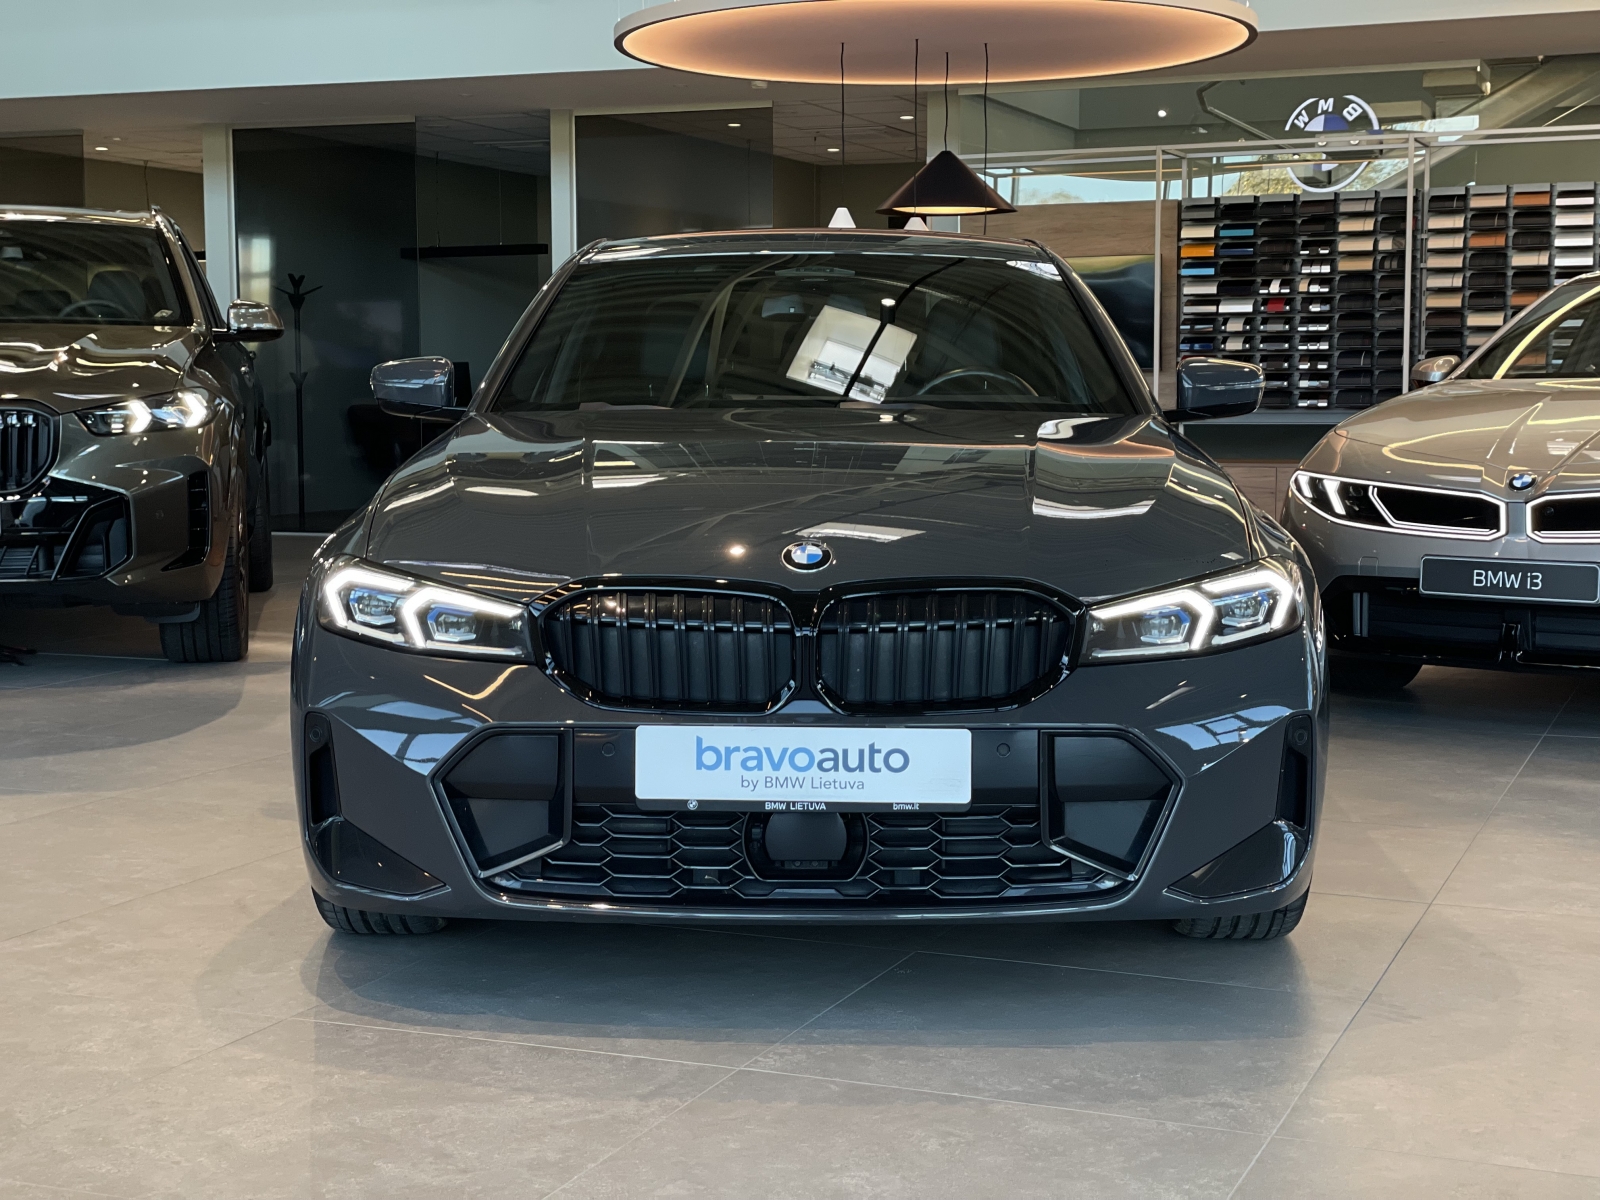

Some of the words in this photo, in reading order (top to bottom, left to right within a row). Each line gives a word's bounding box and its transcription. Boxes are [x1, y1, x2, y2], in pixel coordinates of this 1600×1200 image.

[1473, 569, 1522, 589] BMW
[1526, 572, 1542, 590] i3
[695, 735, 910, 774] bravoauto
[740, 775, 758, 792] by
[764, 776, 806, 790] BMW
[810, 777, 865, 791] Lietuva
[764, 801, 787, 811] BMW
[790, 801, 826, 811] LIETUVA
[892, 802, 920, 811] bmw.lt
